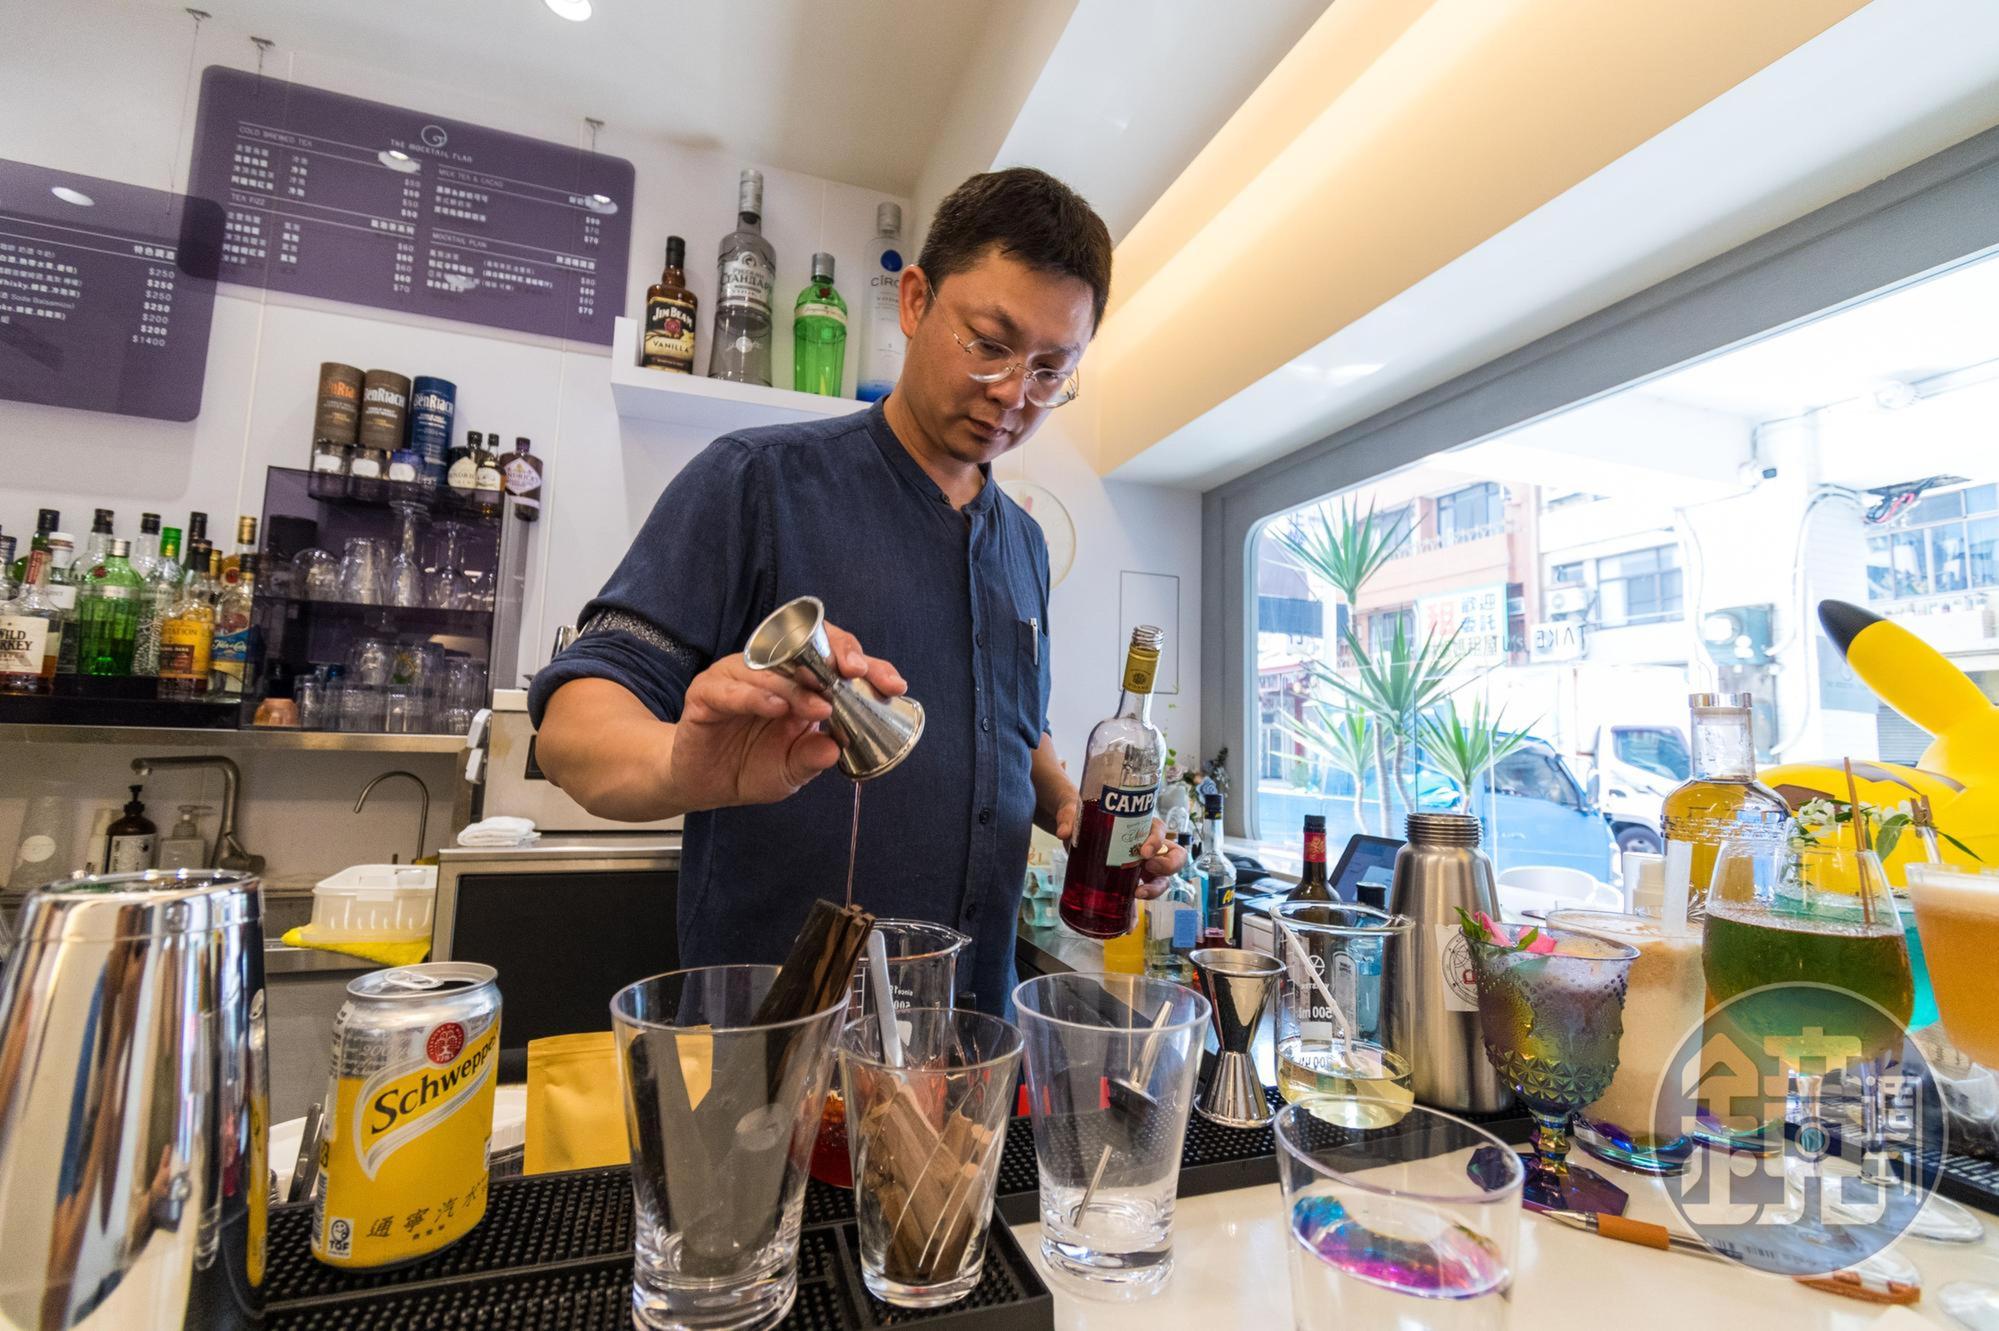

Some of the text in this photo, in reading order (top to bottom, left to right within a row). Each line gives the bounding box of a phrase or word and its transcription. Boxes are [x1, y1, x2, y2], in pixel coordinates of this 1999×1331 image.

[298, 138, 313, 147] TEA
[457, 171, 471, 182] TEA
[231, 192, 246, 202] TEA
[432, 232, 488, 249] MOCKTAIL PLAN
[148, 267, 175, 280] $250
[147, 278, 174, 291] $250
[145, 290, 172, 303] $250
[144, 301, 170, 314] $250
[142, 313, 169, 325] $200
[652, 306, 693, 328] JIM BEAM
[140, 324, 167, 336] $200
[132, 334, 166, 347] $1400
[653, 340, 690, 354] VANILLA
[0, 640, 33, 652] RKEY
[1104, 791, 1155, 814] CAMP
[329, 1239, 350, 1251] TQF
